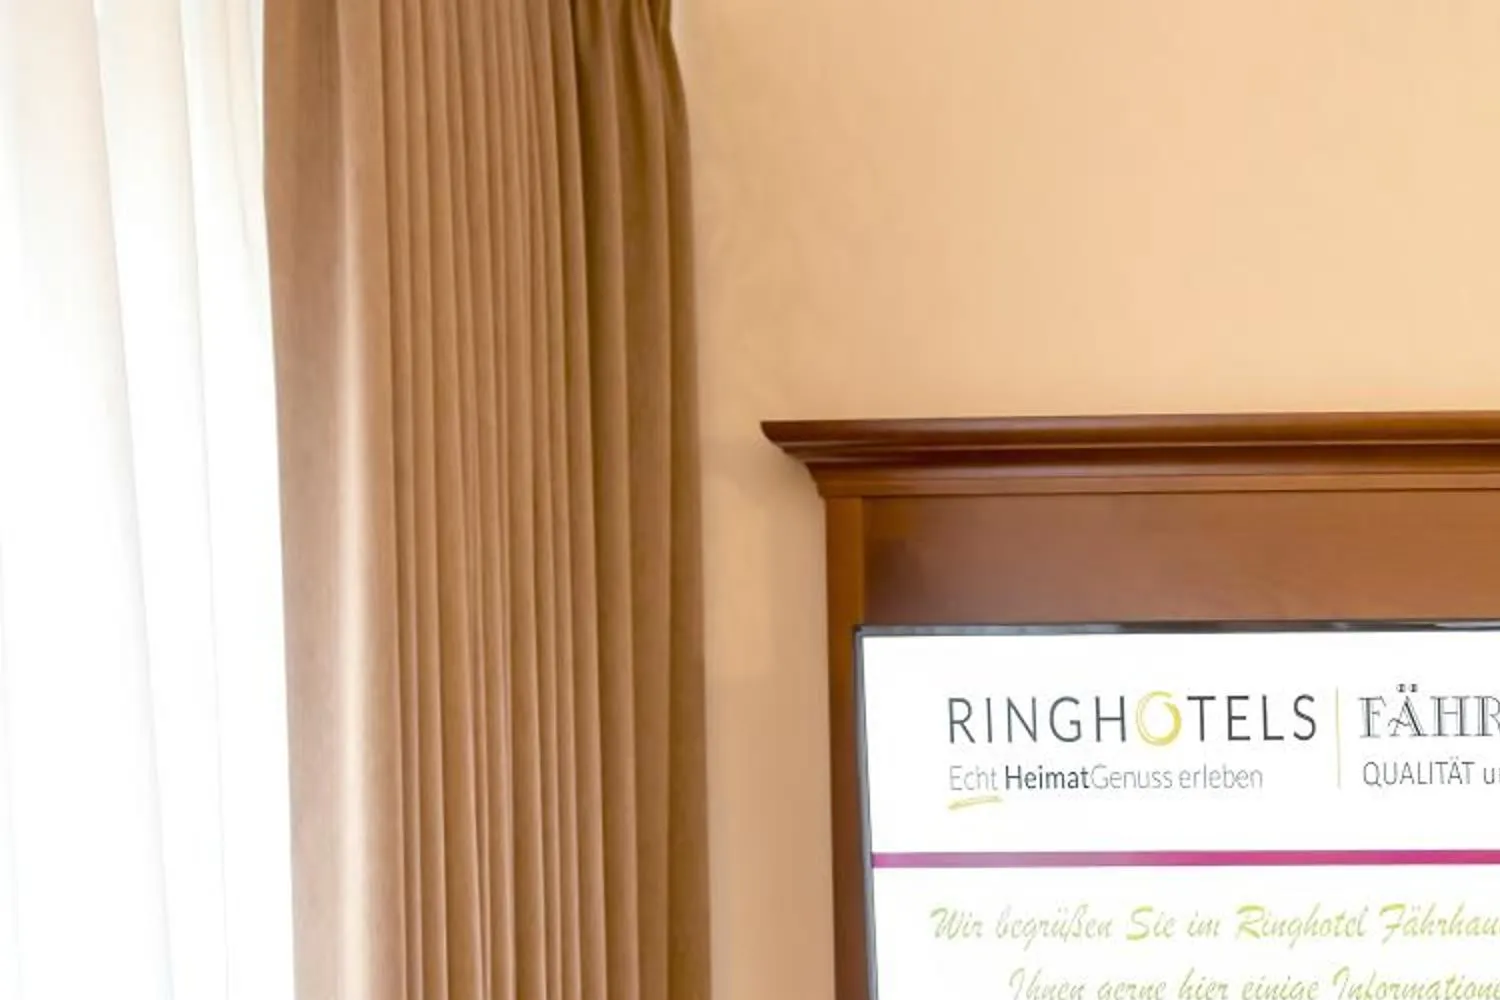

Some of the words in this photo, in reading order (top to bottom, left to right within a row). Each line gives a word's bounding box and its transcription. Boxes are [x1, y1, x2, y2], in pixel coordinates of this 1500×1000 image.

[948, 691, 1317, 746] RINGHOTELS
[949, 765, 998, 791] Echt
[1004, 764, 1173, 791] HeimatGenuss
[1178, 764, 1263, 790] erleben
[1363, 756, 1475, 787] QUALITÄT
[929, 906, 983, 940] Wir
[995, 903, 1112, 950] begrüßen
[1126, 905, 1176, 941] Sie
[1186, 912, 1221, 938] im
[1235, 903, 1369, 949] Ringhotel
